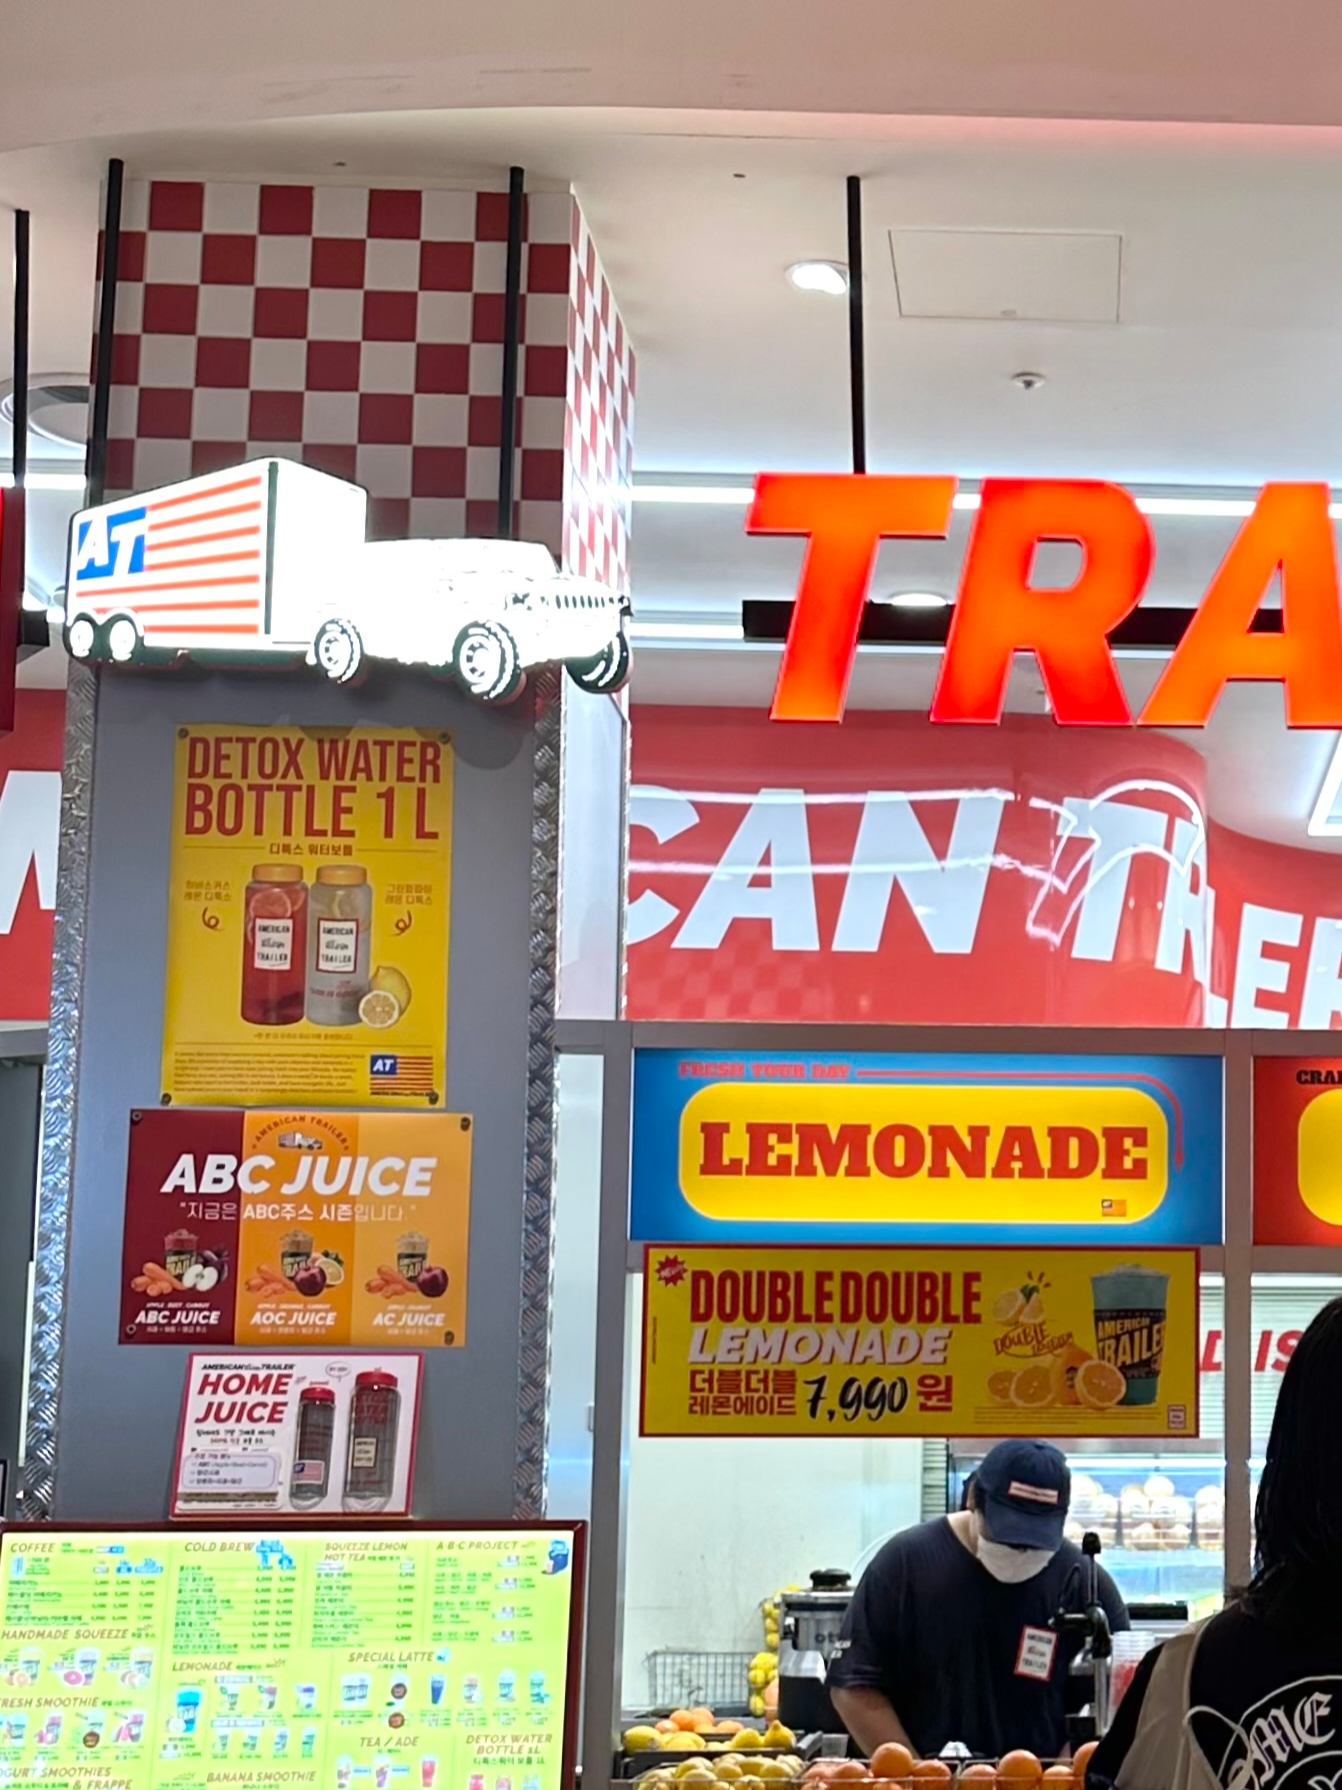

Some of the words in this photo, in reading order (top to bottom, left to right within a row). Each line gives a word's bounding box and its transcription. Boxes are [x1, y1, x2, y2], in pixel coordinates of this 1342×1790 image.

[76, 508, 147, 576] AT
[187, 736, 302, 783] DETOX
[317, 738, 441, 784] WATER
[185, 783, 355, 839] BOTTLE
[269, 845, 303, 856] 디톡스
[372, 1058, 394, 1072] AT
[679, 1062, 745, 1079] FRESH
[751, 1063, 805, 1080] YOUR
[812, 1064, 850, 1079] DAY
[255, 1115, 305, 1142] AMERICAN
[310, 1116, 348, 1145] TRAILER
[699, 1122, 1148, 1180] LEMONADE
[160, 1153, 275, 1195] ABC
[280, 1155, 438, 1198] JUICE
[242, 1204, 315, 1222] ABC주스
[690, 1270, 834, 1324] DOUBLE
[840, 1271, 982, 1325] DOUBLE
[135, 1310, 170, 1324] ABC
[171, 1310, 220, 1324] JUICE
[251, 1312, 286, 1325] AOC
[288, 1312, 337, 1325] JUICE
[373, 1313, 396, 1326] AC
[397, 1314, 446, 1326] JUICE
[688, 1328, 955, 1366] LEMONADE
[197, 1373, 293, 1396] HOME
[690, 1370, 796, 1394] 더블더블
[804, 1375, 909, 1421] 7,990
[917, 1374, 953, 1413] 원
[688, 1395, 797, 1416] 레몬에이드
[194, 1402, 288, 1424] JUICE
[10, 1543, 55, 1553] COFFEE
[184, 1542, 216, 1552] COLD
[220, 1542, 255, 1552] BREW
[325, 1543, 370, 1551] SQUEEZE
[372, 1542, 408, 1551] LEMON
[468, 1541, 519, 1550] PROJECT
[324, 1553, 346, 1561] HOT
[348, 1553, 365, 1561] TEA
[1, 1629, 69, 1641] HANDMADE
[74, 1629, 128, 1640] SQUEEZE
[348, 1652, 395, 1662] SPECIAL
[399, 1652, 434, 1662] LATTE
[172, 1662, 233, 1671] LEMONADE
[0, 1698, 33, 1708] RESH
[35, 1697, 99, 1708] SMOOTHIE
[360, 1737, 380, 1747] TEA
[395, 1736, 419, 1747] ADE
[466, 1734, 507, 1744] DETOX
[511, 1734, 553, 1744] WATER
[477, 1745, 524, 1755] BOTTLE
[0, 1767, 38, 1778] OGURT
[40, 1767, 111, 1778] SMOOTHIES
[207, 1772, 253, 1782] BANANA
[256, 1771, 316, 1782] SMOOTHIE
[87, 1779, 133, 1790] FRAPPE
